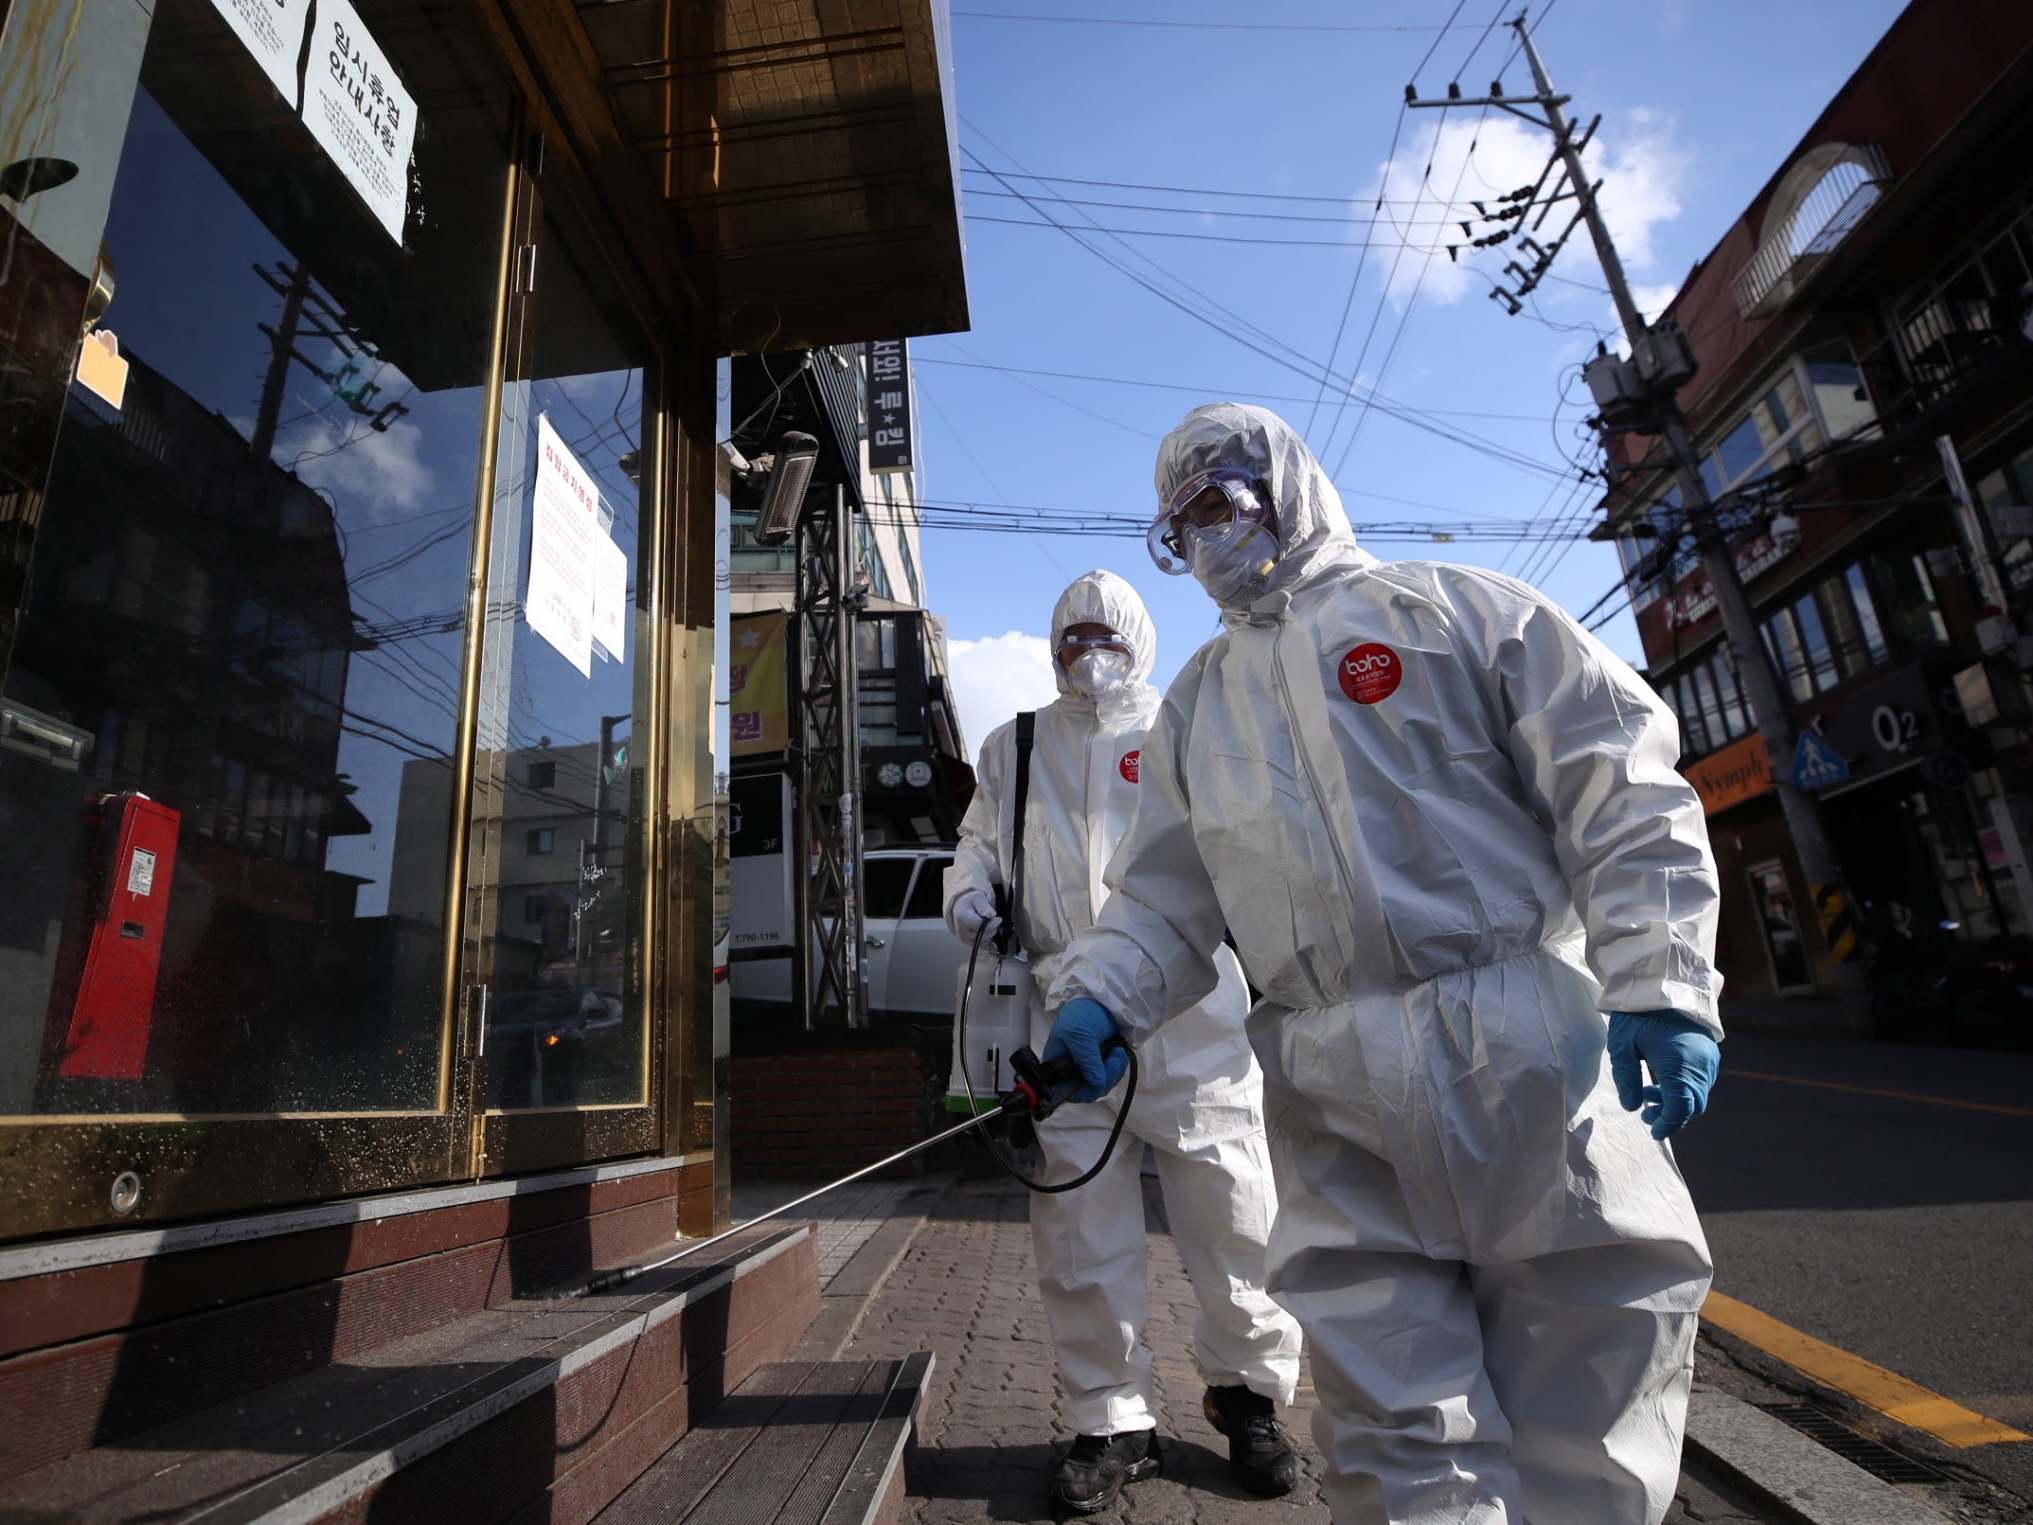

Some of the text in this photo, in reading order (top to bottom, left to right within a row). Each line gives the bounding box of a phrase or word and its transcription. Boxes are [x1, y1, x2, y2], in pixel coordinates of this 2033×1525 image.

[329, 50, 396, 158] 안내사항
[333, 21, 400, 131] 임시휴업
[762, 838, 779, 851] 3F
